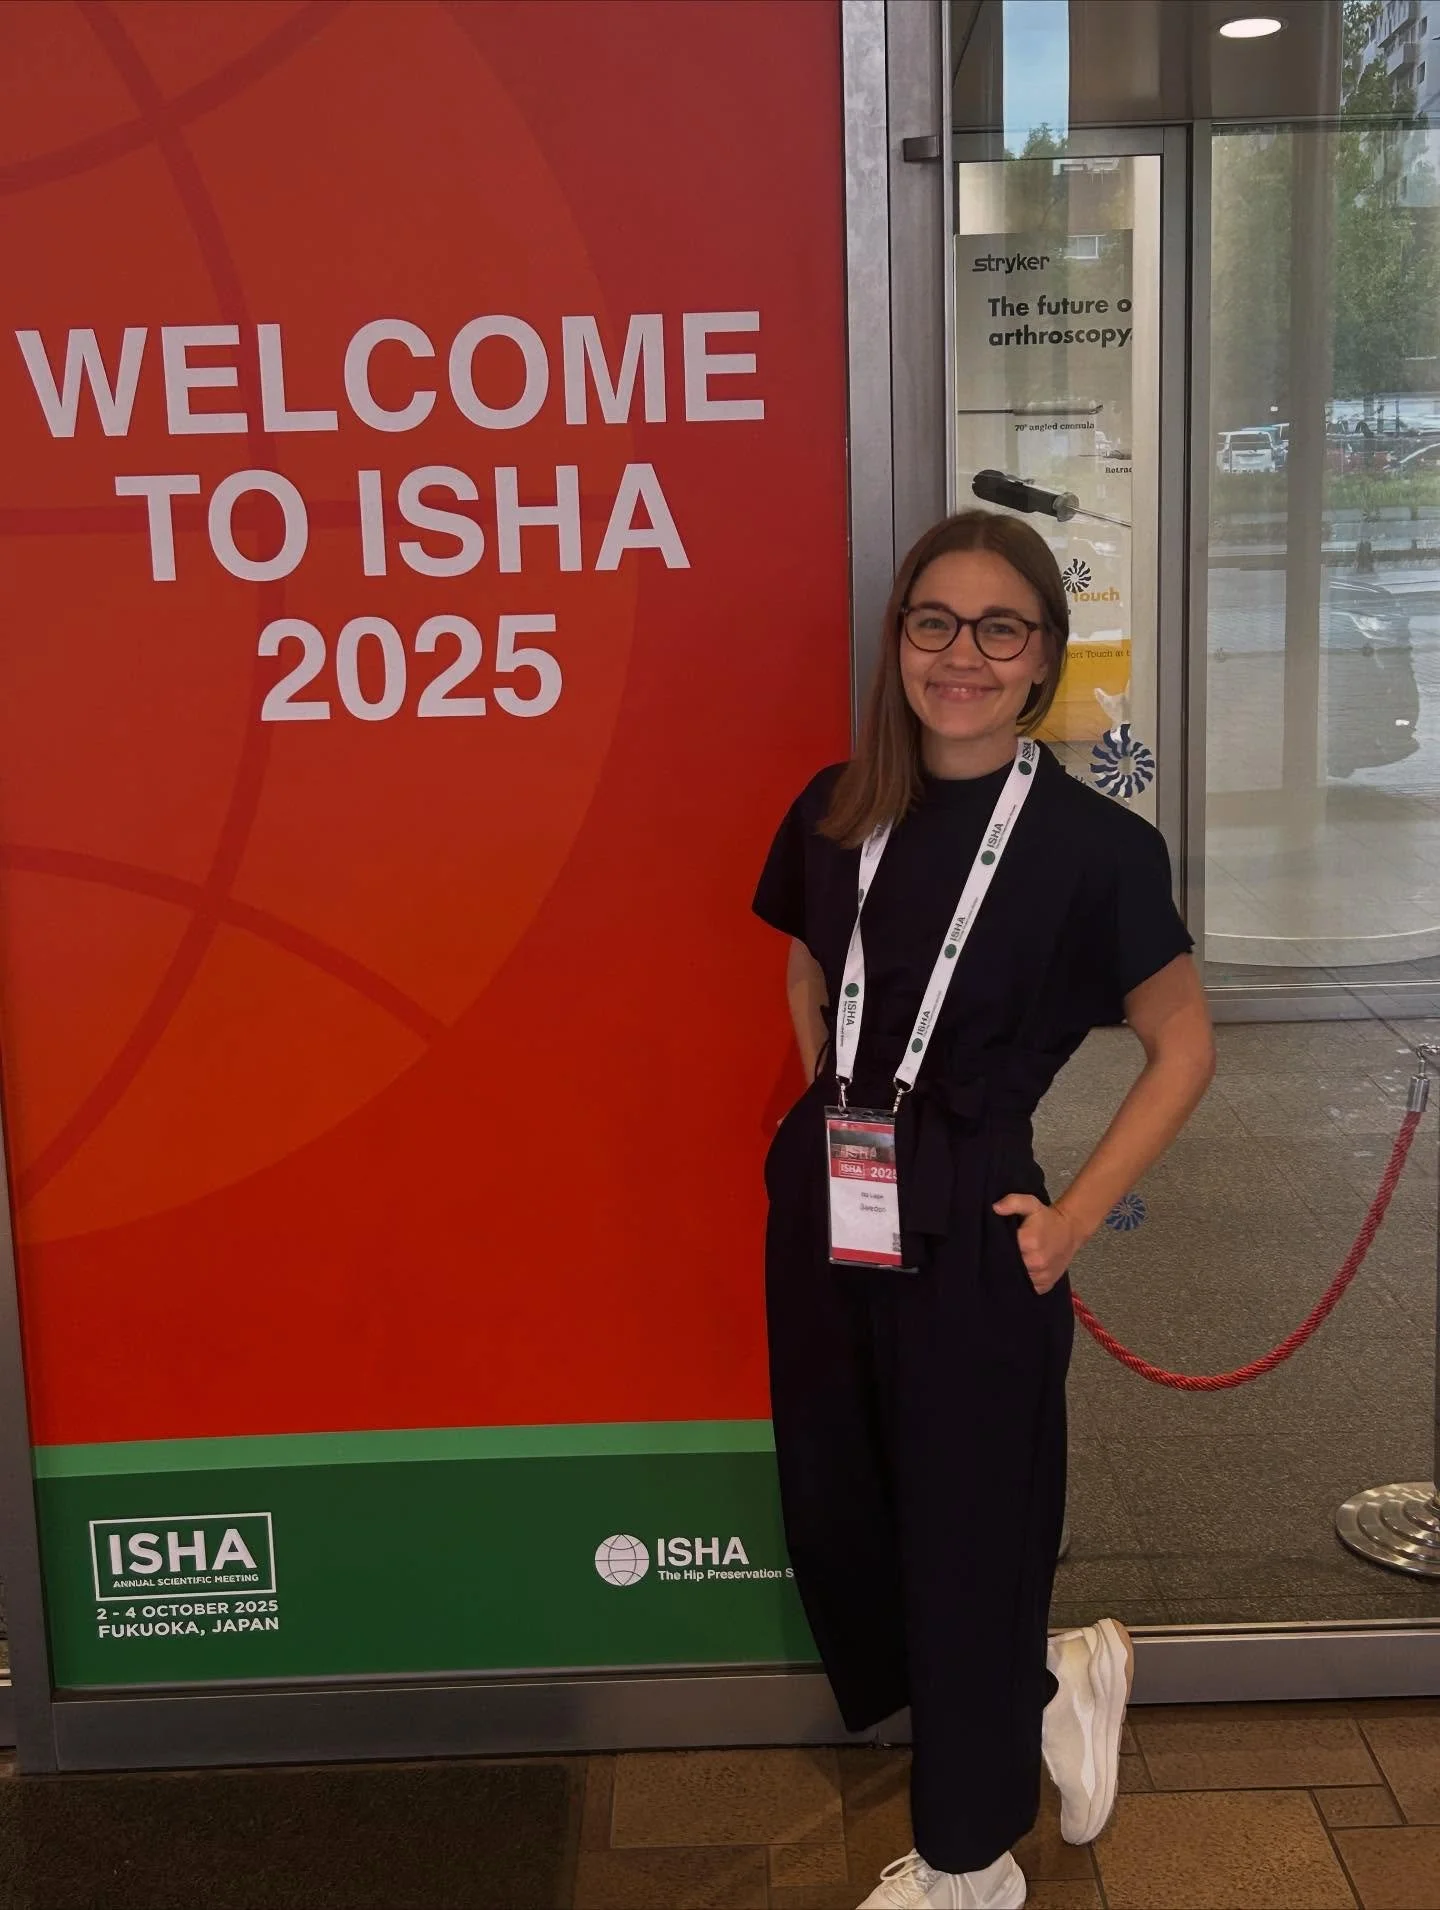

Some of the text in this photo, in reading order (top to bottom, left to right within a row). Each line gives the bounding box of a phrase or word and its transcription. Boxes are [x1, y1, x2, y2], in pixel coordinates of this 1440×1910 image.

[972, 253, 1050, 274] stryker
[988, 296, 1029, 317] The
[1037, 294, 1109, 316] future
[15, 311, 765, 438] WELCOME
[1029, 422, 1058, 432] angled
[115, 463, 691, 582] TO ISHA
[257, 614, 563, 721] 2025
[987, 823, 1004, 848] ISHA
[950, 916, 966, 942] ISHA
[845, 1000, 857, 1026] ISHA
[916, 1010, 931, 1035] ISHA
[840, 1163, 862, 1173] ISHA
[109, 1528, 257, 1575] ISHA
[657, 1536, 749, 1567] ISHA
[113, 1573, 259, 1588] ANNUAL SCIENTIFIC MEETING
[657, 1570, 681, 1580] The
[684, 1569, 704, 1581] Hip
[707, 1568, 782, 1579] Preservation
[96, 1607, 107, 1620] 2
[125, 1606, 136, 1619] 4
[142, 1602, 229, 1618] OCTOBER
[234, 1599, 279, 1614] 2025
[98, 1616, 279, 1638] FUKUOKA, JAPAN
